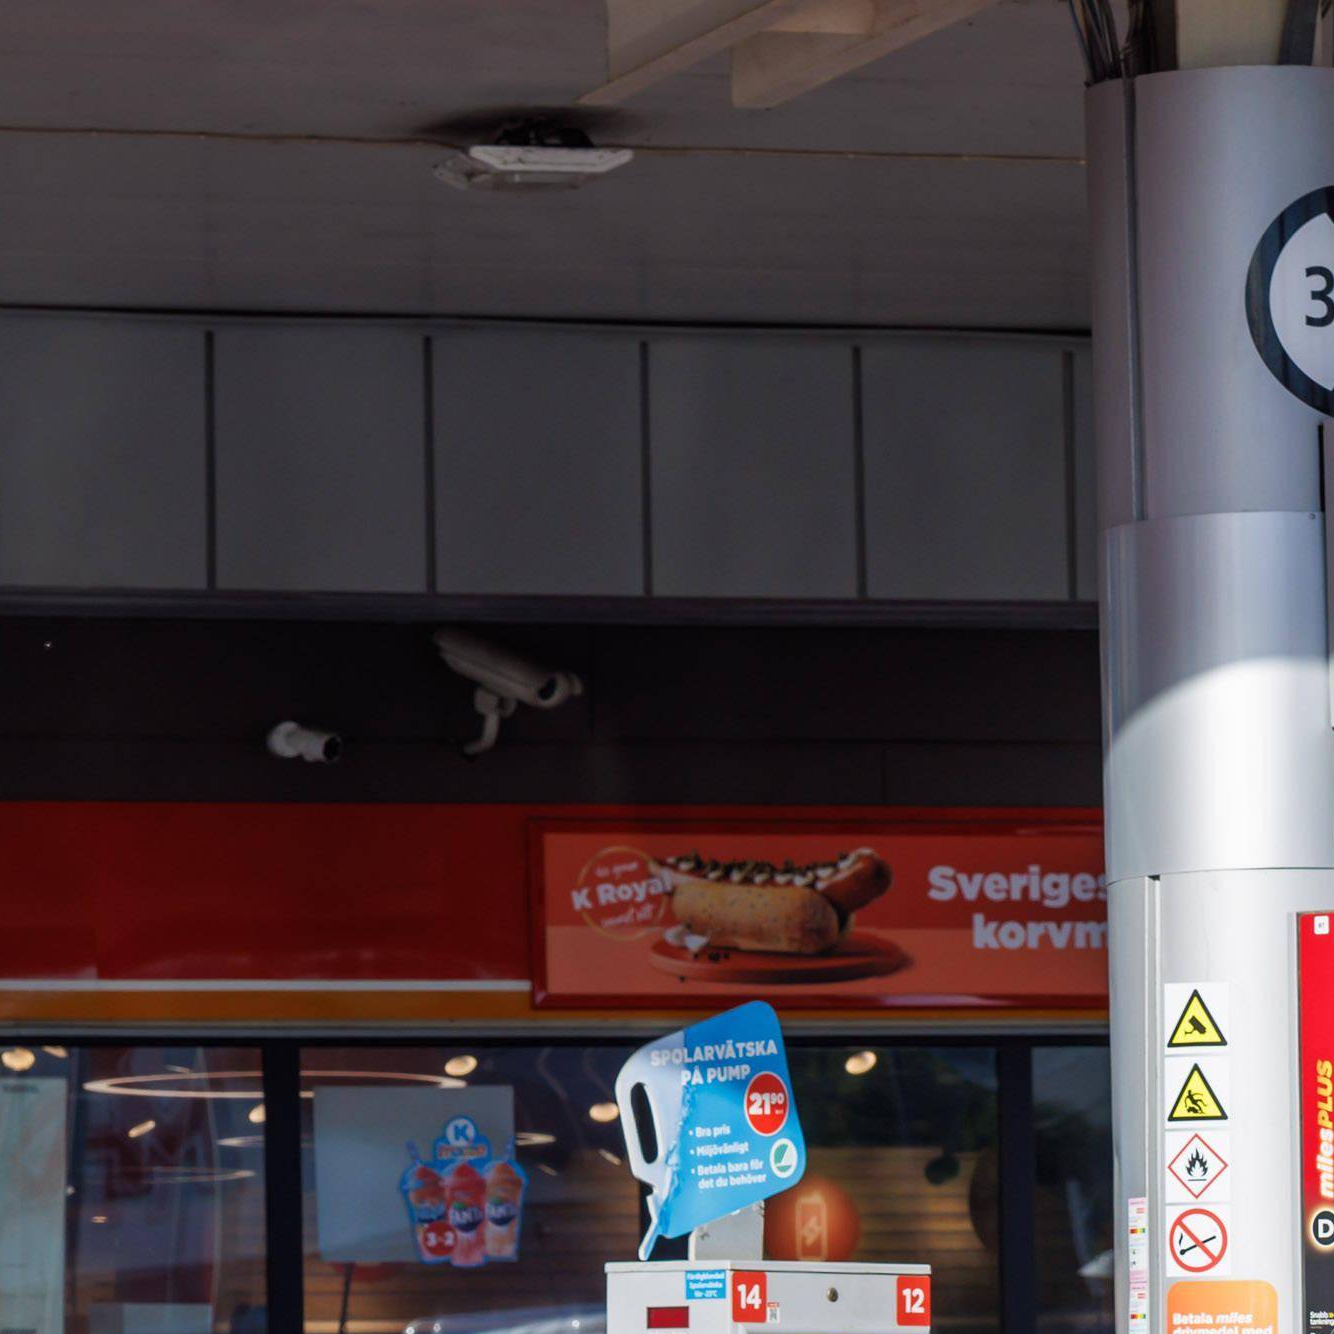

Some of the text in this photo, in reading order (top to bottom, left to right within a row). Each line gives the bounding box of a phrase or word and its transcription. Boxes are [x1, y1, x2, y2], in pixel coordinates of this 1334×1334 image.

[571, 888, 592, 912] K
[651, 1039, 778, 1067] SPOLARVÄTSKA
[681, 1065, 750, 1086] PÅ PUMP
[696, 1124, 731, 1138] Bra pris
[697, 1159, 764, 1176] Betala bara för
[698, 1173, 766, 1189] det du behöver
[1317, 1219, 1334, 1238] D
[737, 1284, 762, 1310] 14
[902, 1288, 924, 1314] 12
[1172, 1312, 1253, 1324] Betala miles
